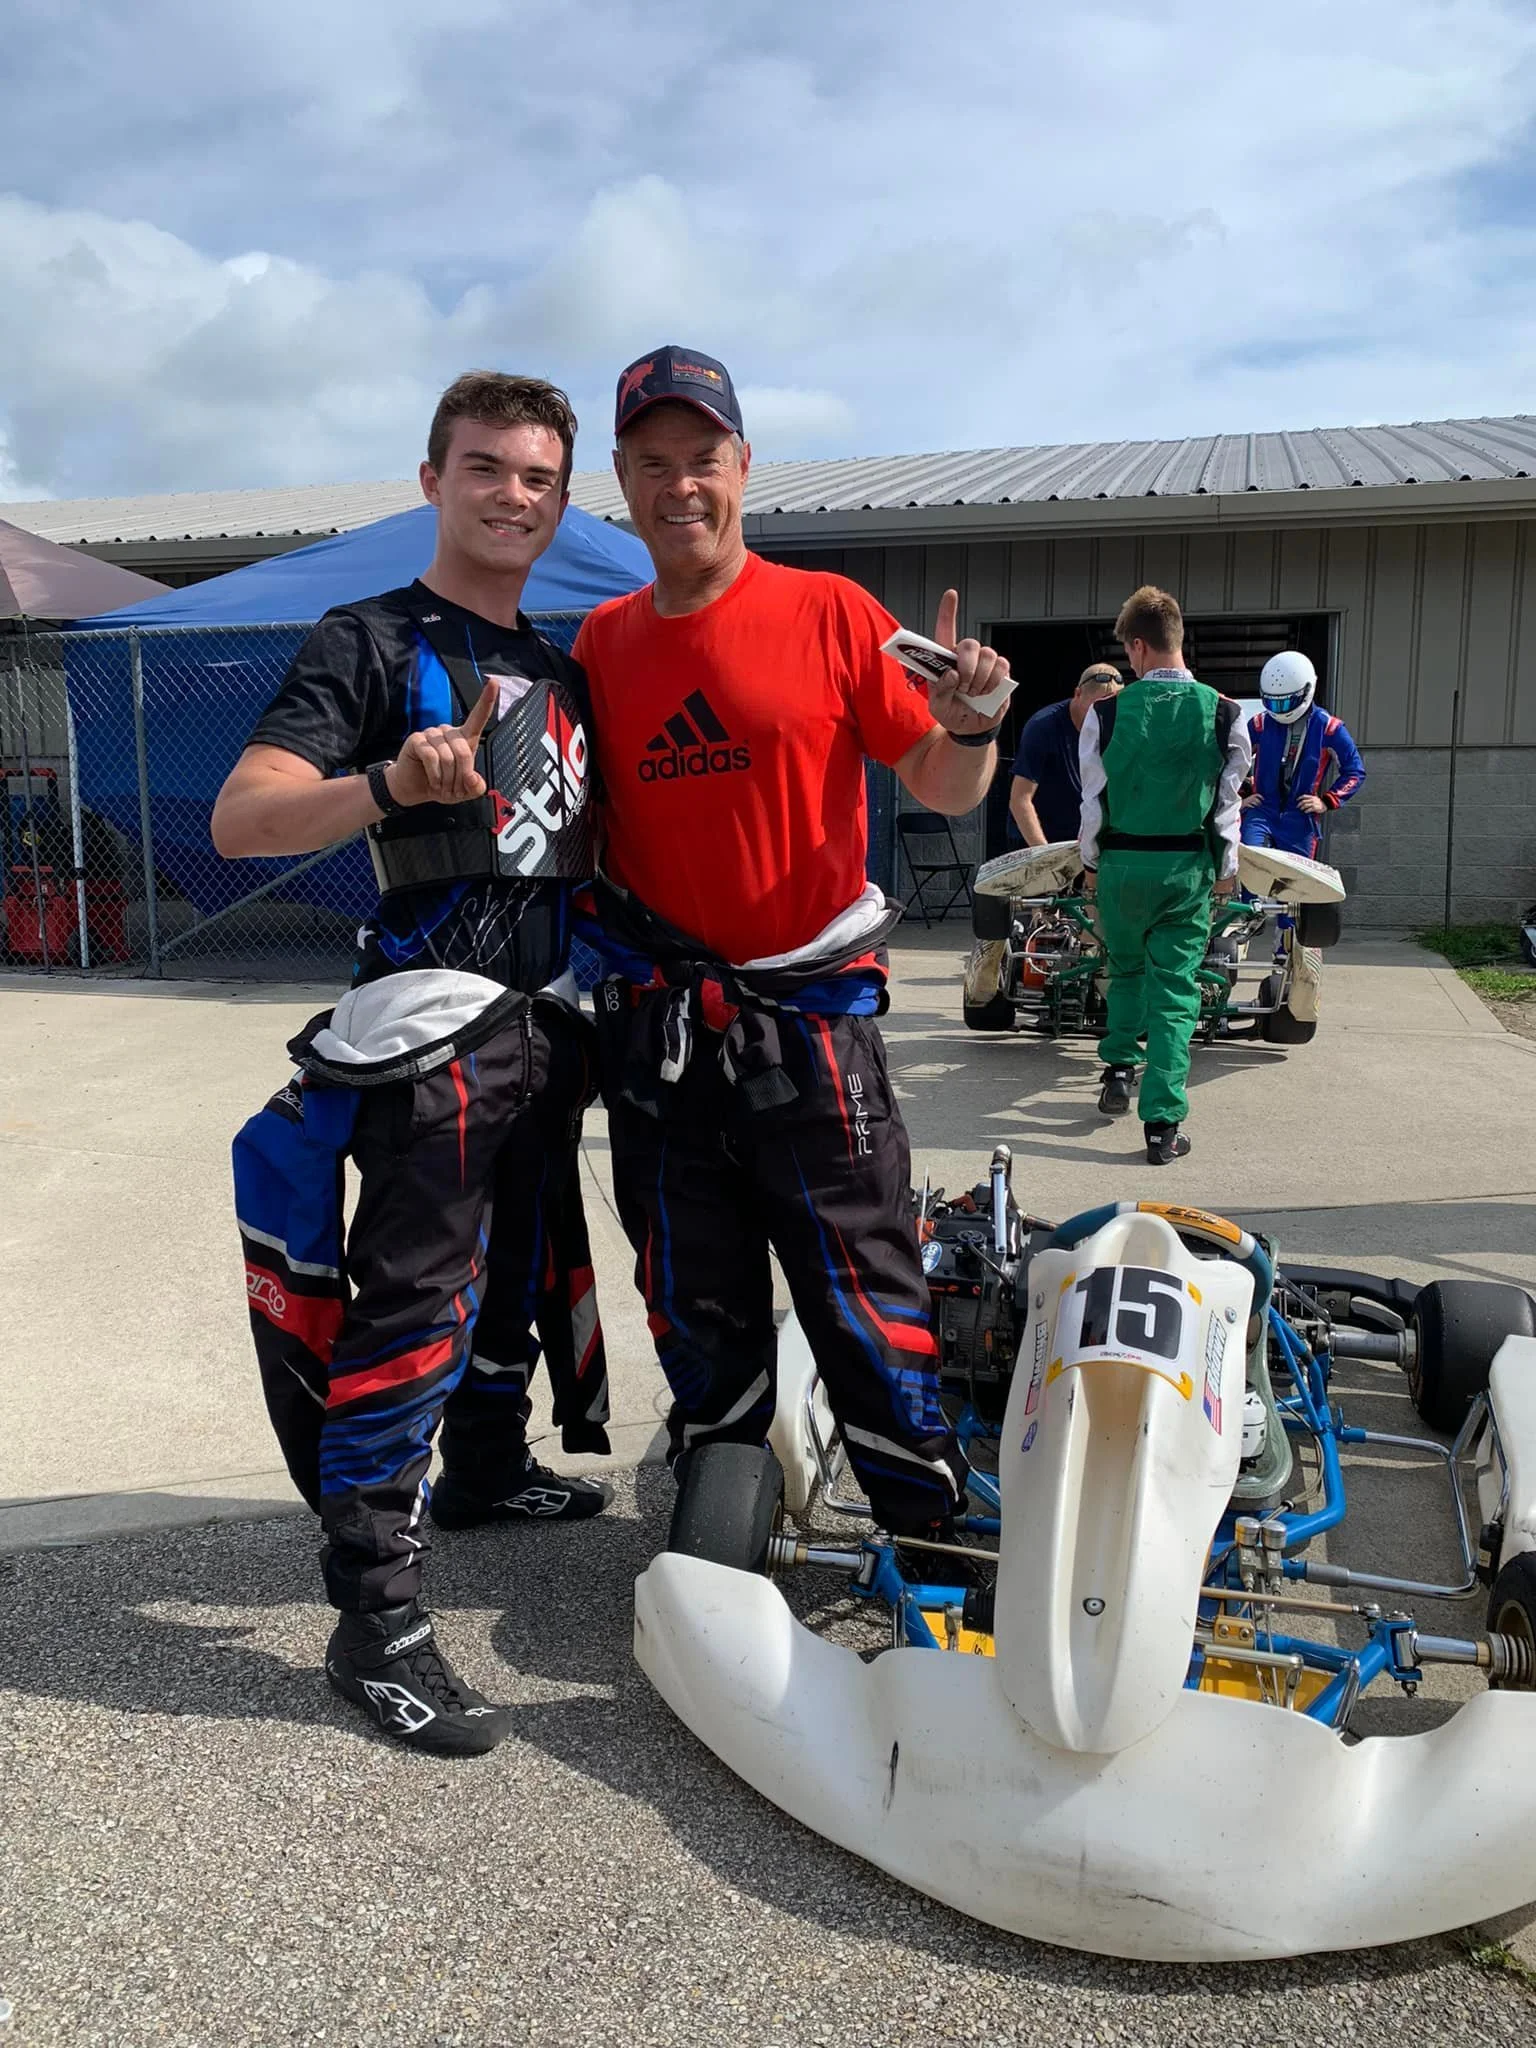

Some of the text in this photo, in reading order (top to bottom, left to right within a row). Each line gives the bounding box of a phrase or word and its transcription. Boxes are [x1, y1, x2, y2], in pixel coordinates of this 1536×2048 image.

[638, 743, 752, 782] adidas
[847, 1072, 873, 1156] PRIME
[1075, 1266, 1183, 1361] 15
